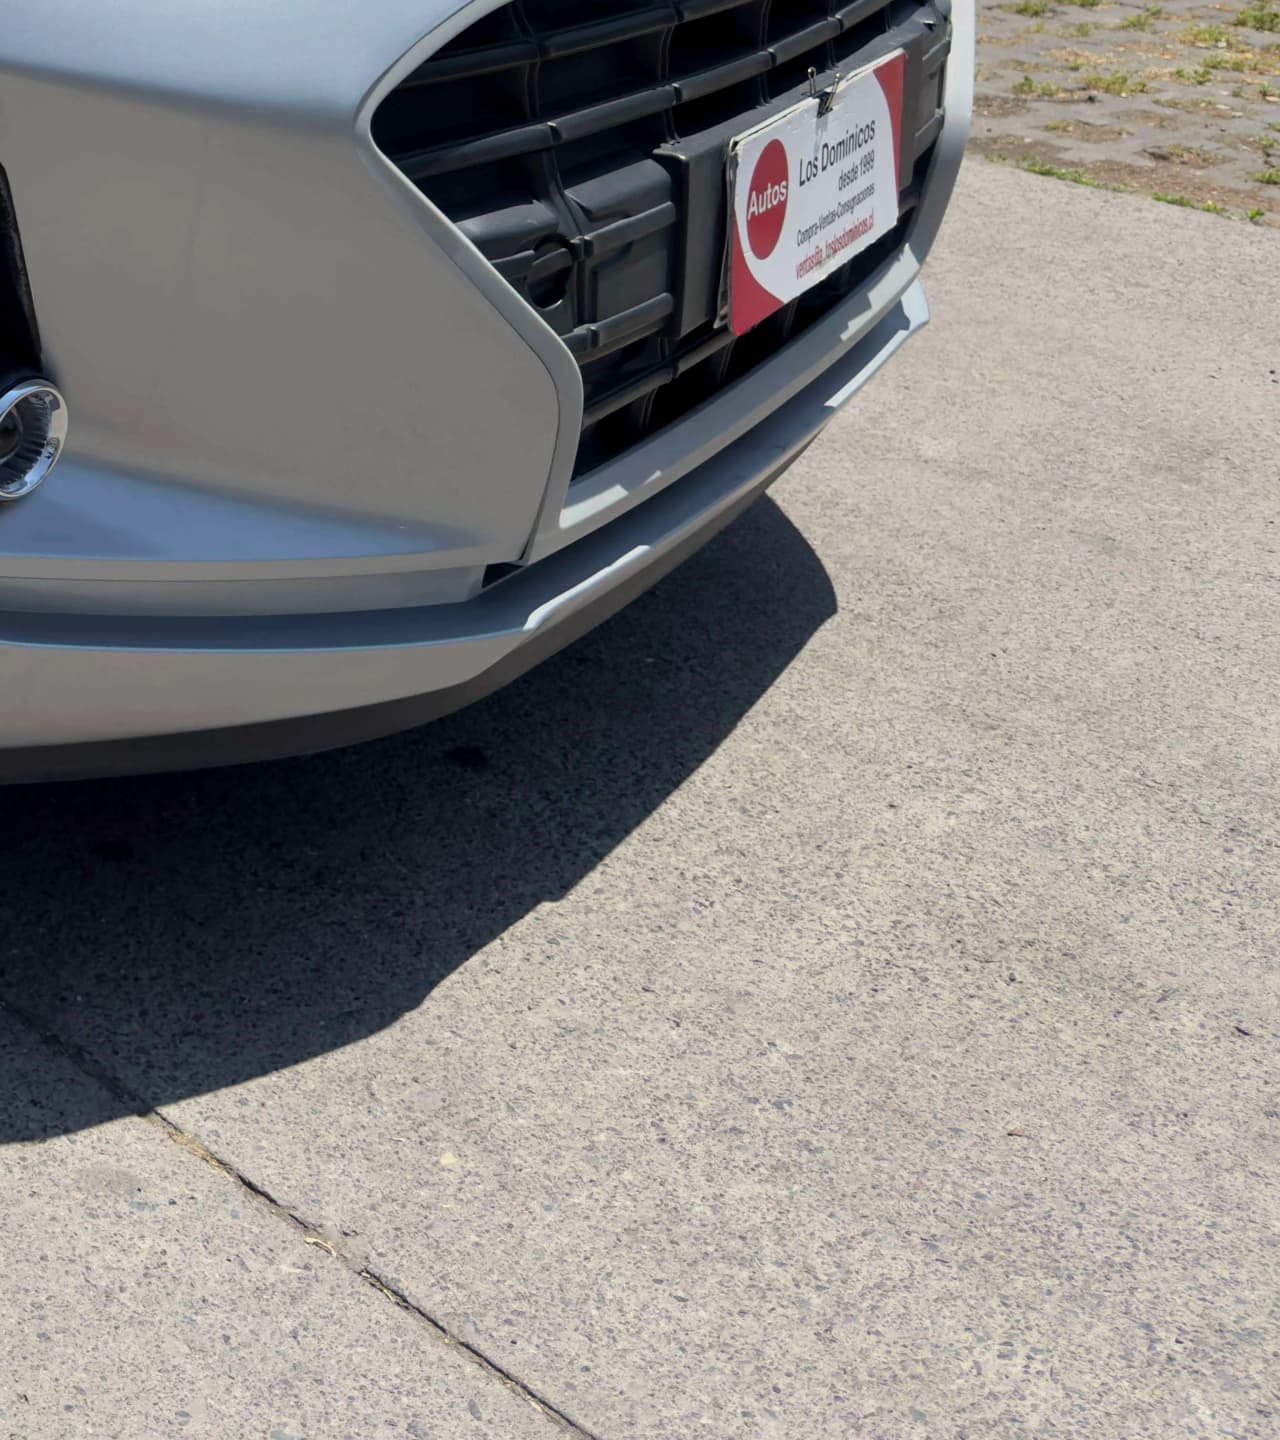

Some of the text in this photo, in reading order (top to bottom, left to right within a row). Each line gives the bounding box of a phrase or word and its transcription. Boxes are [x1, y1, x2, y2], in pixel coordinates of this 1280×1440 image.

[799, 120, 876, 187] Los Dominicos
[838, 162, 858, 191] desde
[748, 180, 787, 222] Autos
